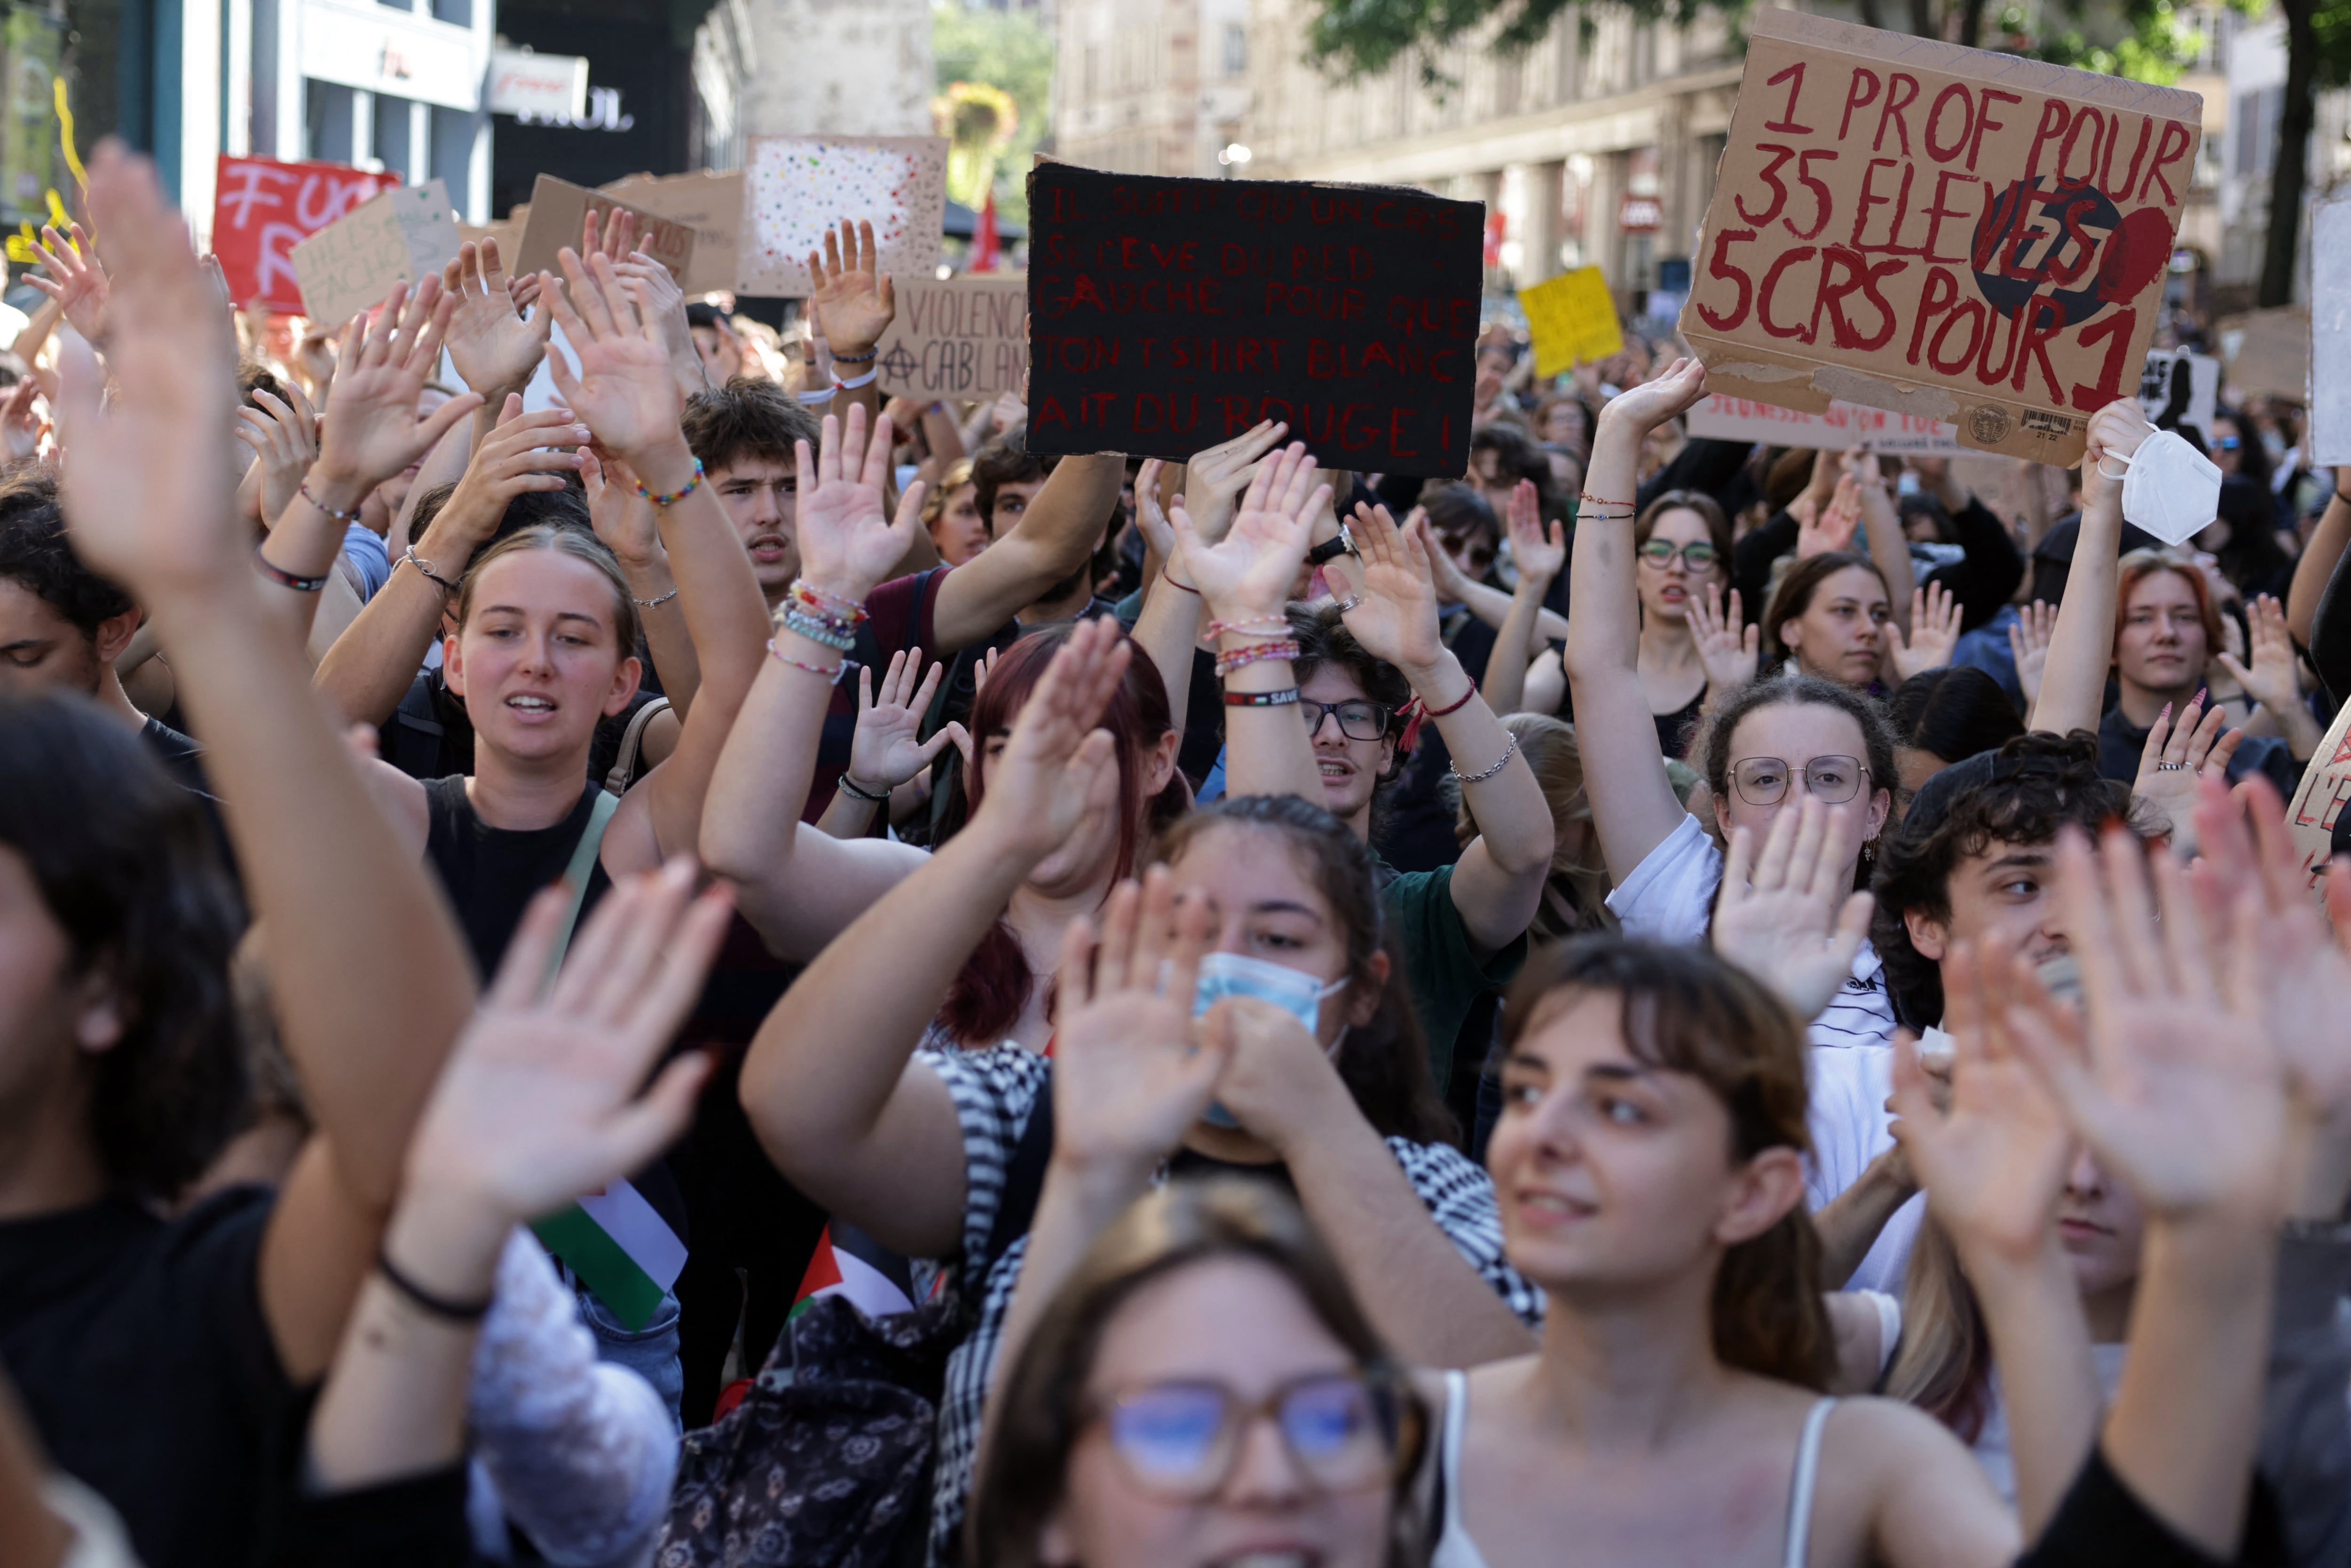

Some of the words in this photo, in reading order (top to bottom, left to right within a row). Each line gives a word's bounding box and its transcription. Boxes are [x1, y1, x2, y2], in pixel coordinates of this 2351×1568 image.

[1765, 62, 1814, 134] 1
[1838, 68, 2022, 171] PROF
[2024, 98, 2191, 205] POUR
[1049, 187, 1087, 223] IL
[1735, 143, 1838, 240] 35
[1850, 158, 2098, 286] ELEVES
[1044, 233, 1085, 268] SE
[1221, 243, 1273, 276] DU
[906, 288, 1028, 341] VIOLENC
[1265, 282, 1366, 323] POUR
[1388, 296, 1473, 338] QUE
[1033, 334, 1120, 374] TON
[1308, 337, 1460, 383] BLANC
[1907, 266, 2067, 406] POUR
[2071, 308, 2137, 413] 1
[1132, 393, 1199, 434] DU
[1223, 394, 1418, 457] ROUGE
